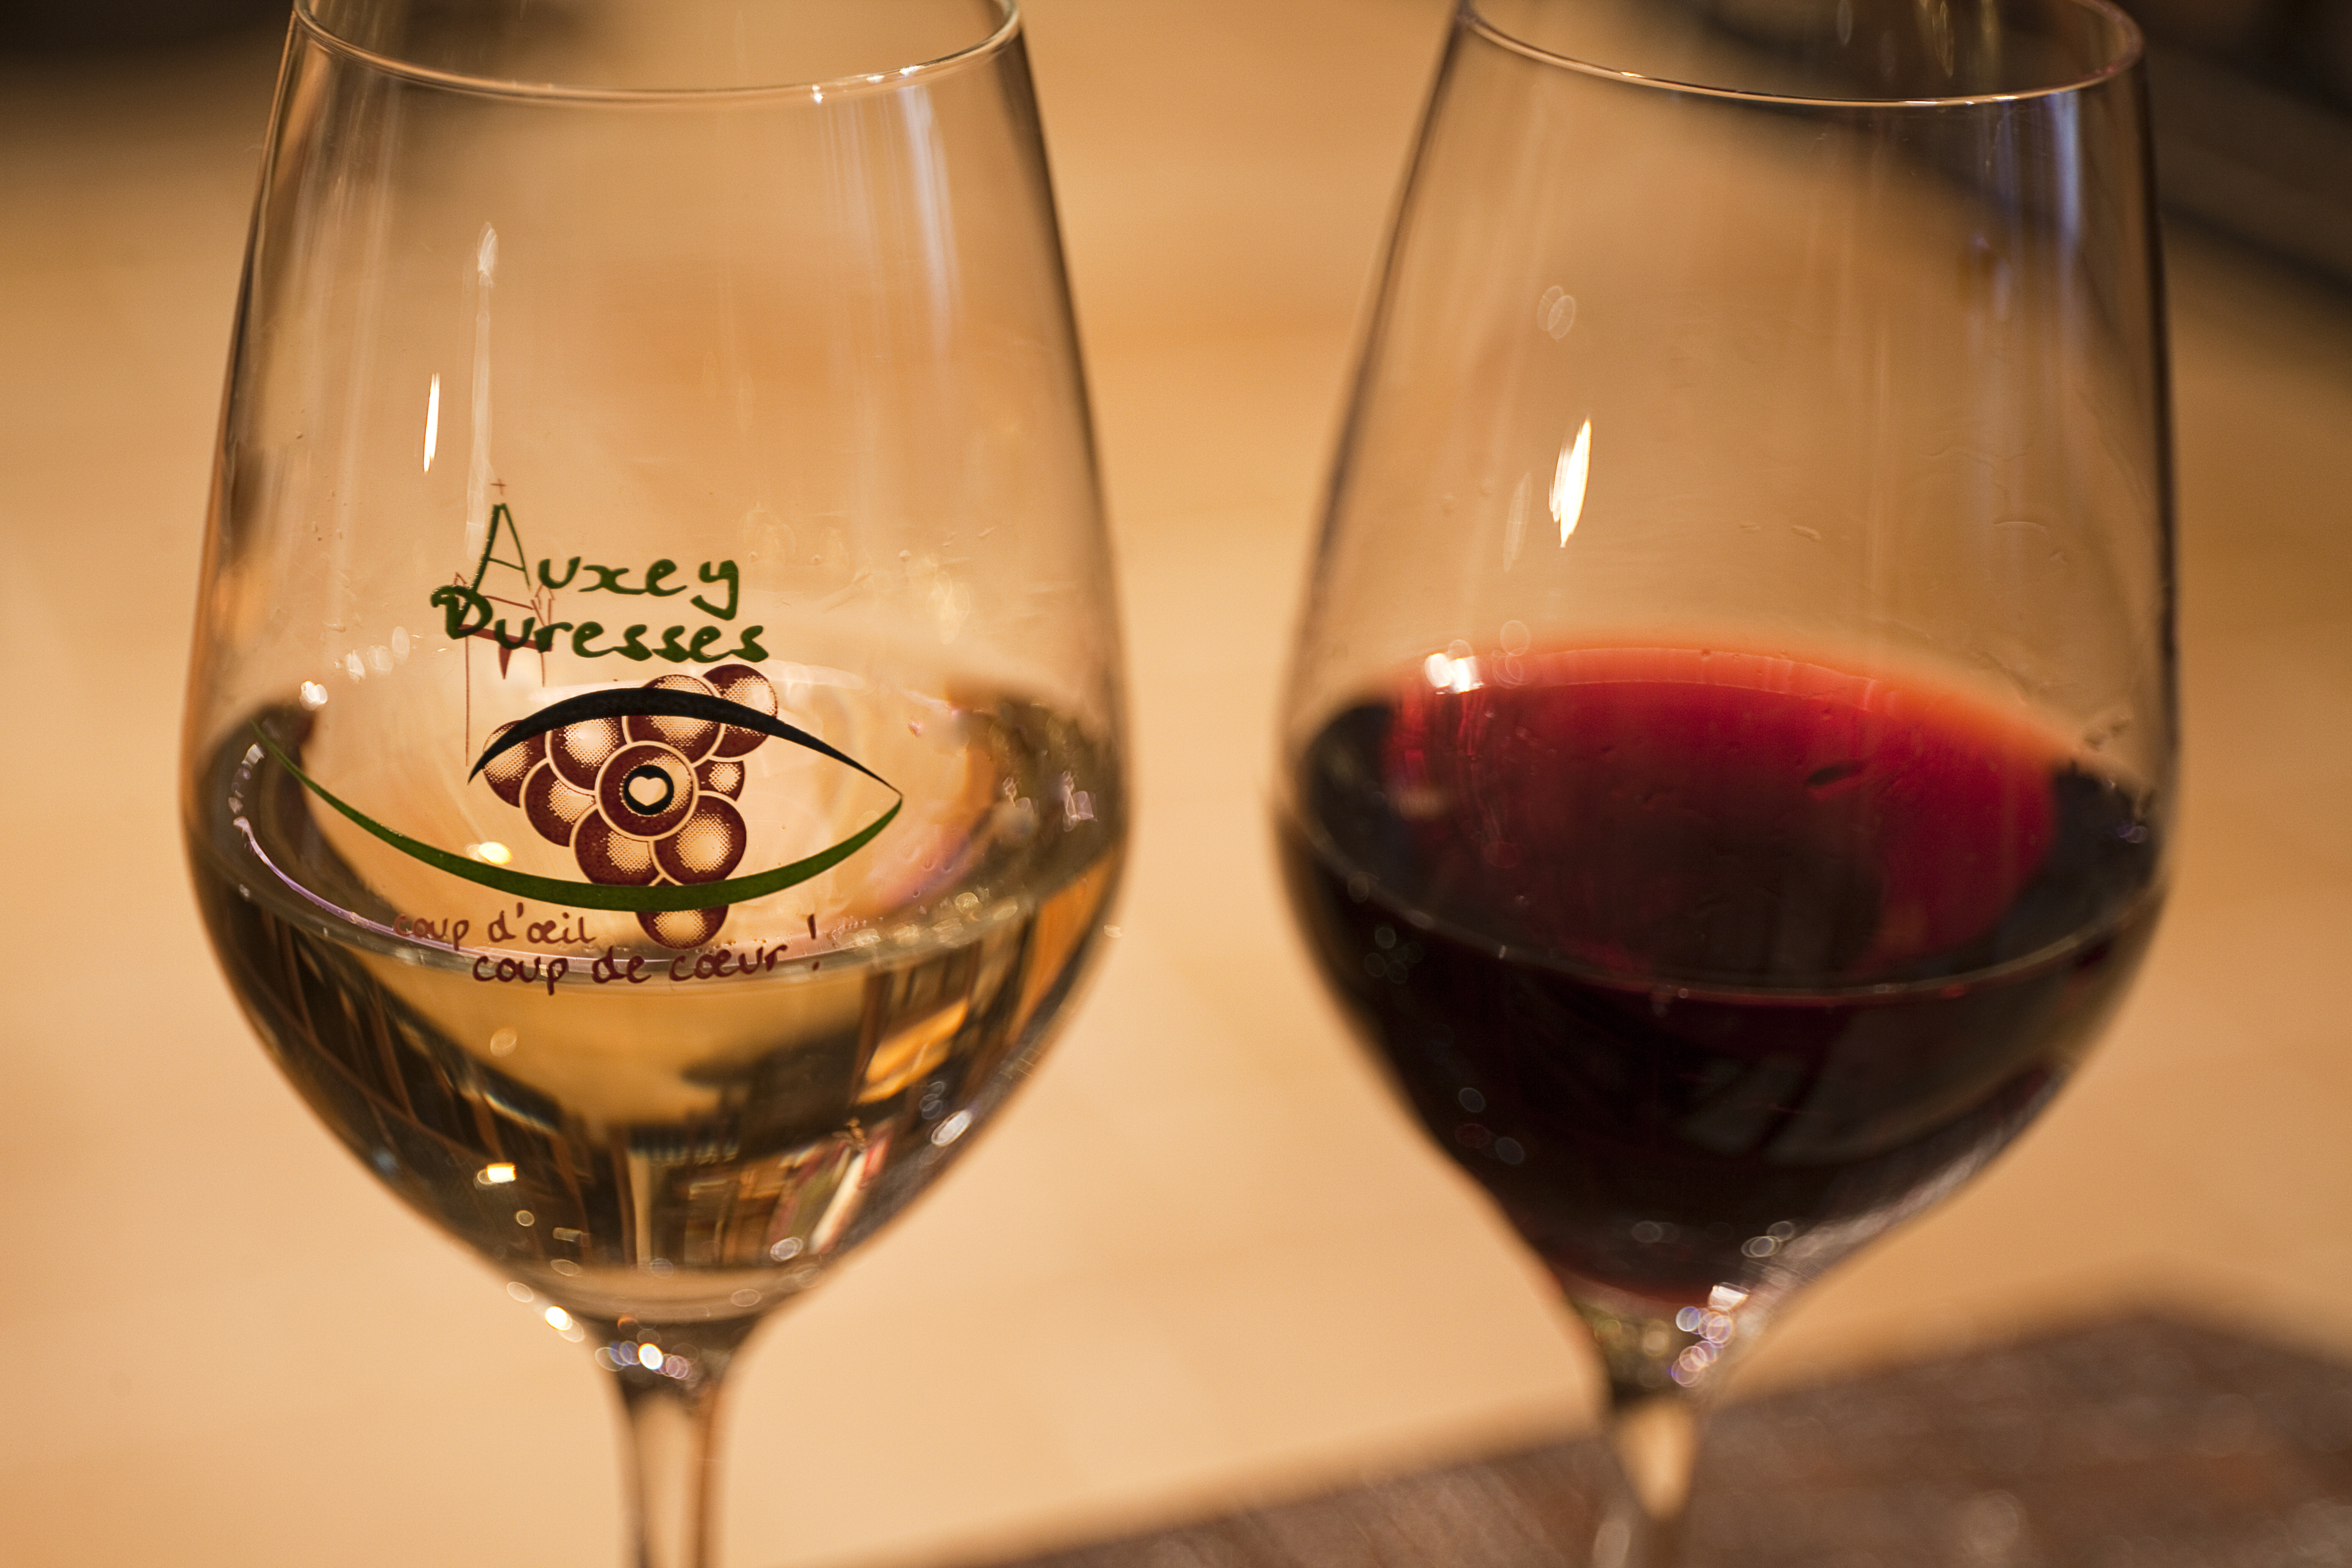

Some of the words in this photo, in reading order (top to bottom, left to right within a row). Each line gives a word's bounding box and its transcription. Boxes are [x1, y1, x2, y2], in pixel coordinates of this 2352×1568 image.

[468, 503, 738, 620] Auxey
[431, 585, 769, 663] Duresses
[393, 915, 469, 951] coup
[472, 956, 569, 995] coup
[592, 945, 652, 983] de
